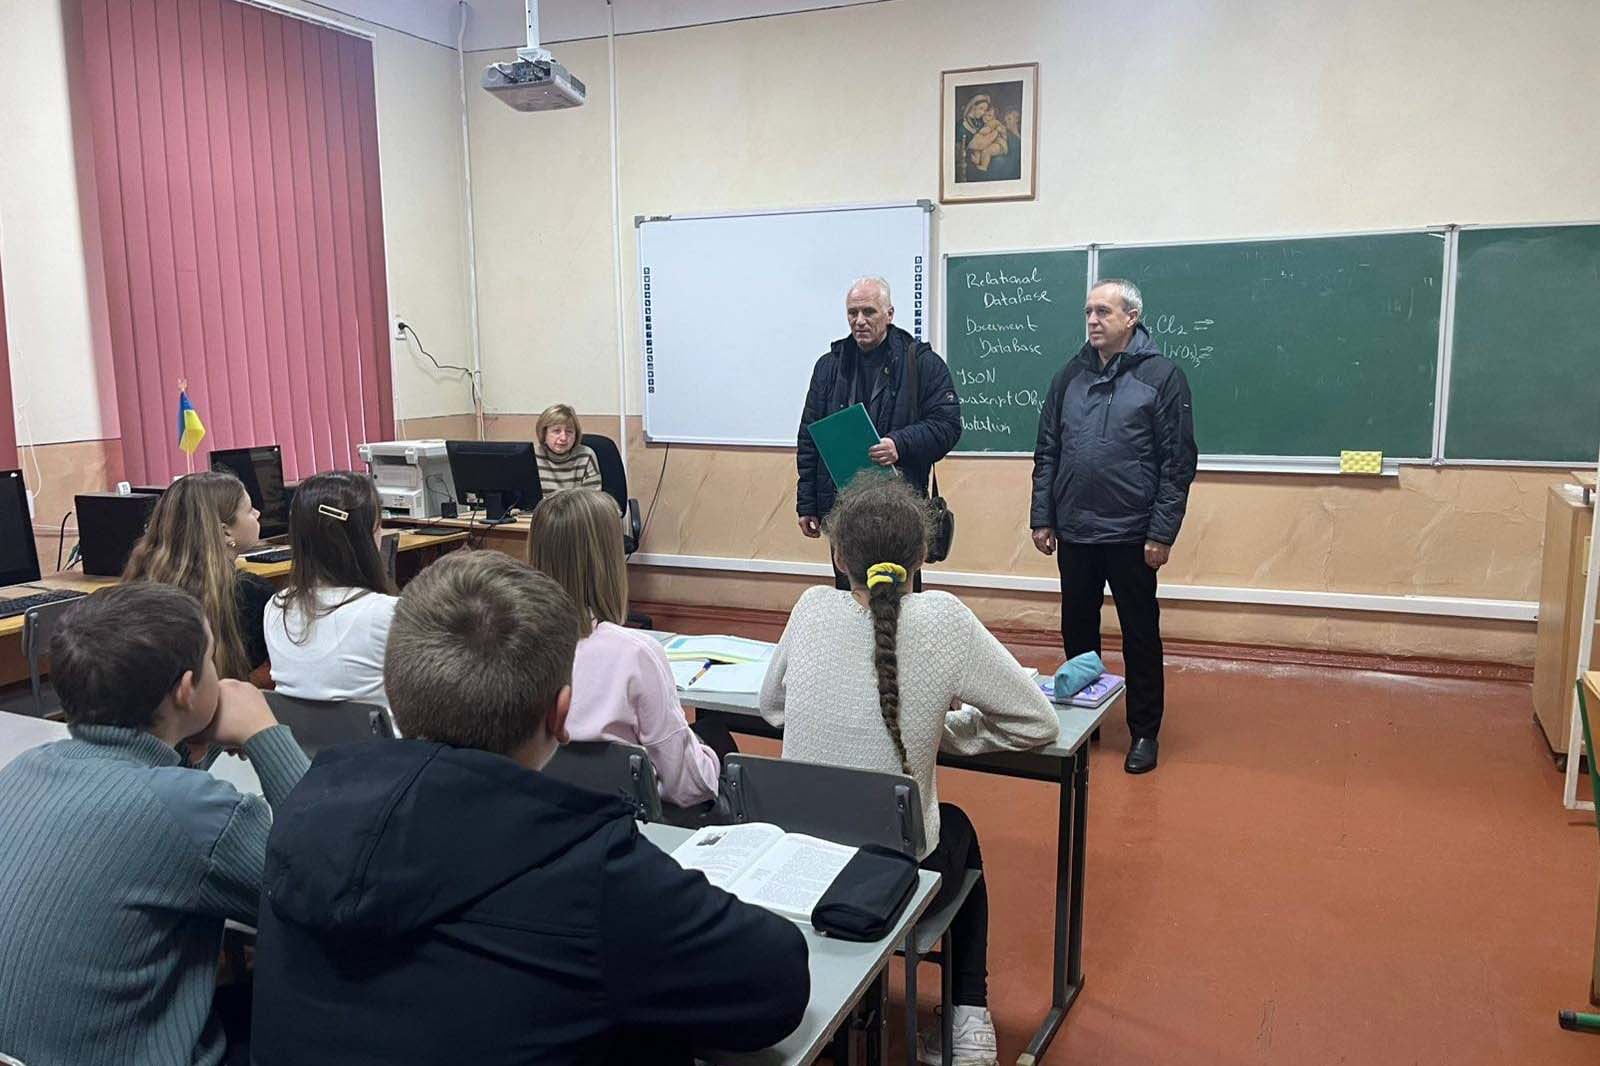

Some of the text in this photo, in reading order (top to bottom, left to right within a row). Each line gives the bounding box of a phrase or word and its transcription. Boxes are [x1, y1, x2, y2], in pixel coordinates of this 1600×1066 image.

[966, 267, 1042, 289] Relational
[984, 287, 1052, 309] Database
[966, 315, 1039, 336] Document
[979, 338, 1042, 358] Database
[957, 368, 996, 385] JSON
[959, 389, 1045, 414] avaScript Obj
